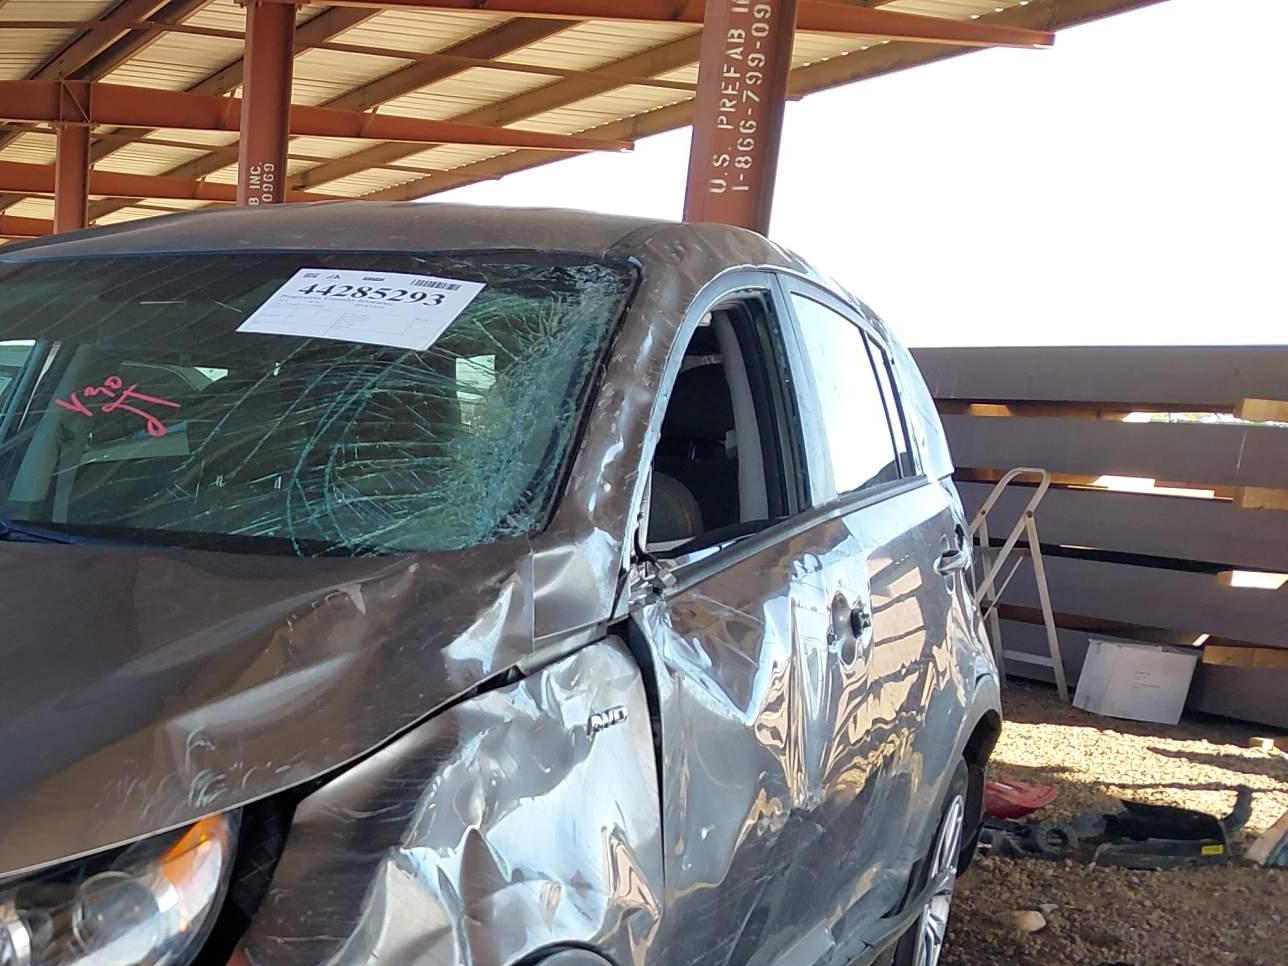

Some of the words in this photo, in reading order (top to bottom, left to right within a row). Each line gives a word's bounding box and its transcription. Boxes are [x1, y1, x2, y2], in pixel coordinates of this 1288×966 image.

[717, 28, 746, 129] PREFAB
[732, 0, 772, 191] 1-866-799-09
[297, 282, 447, 307] 44285293
